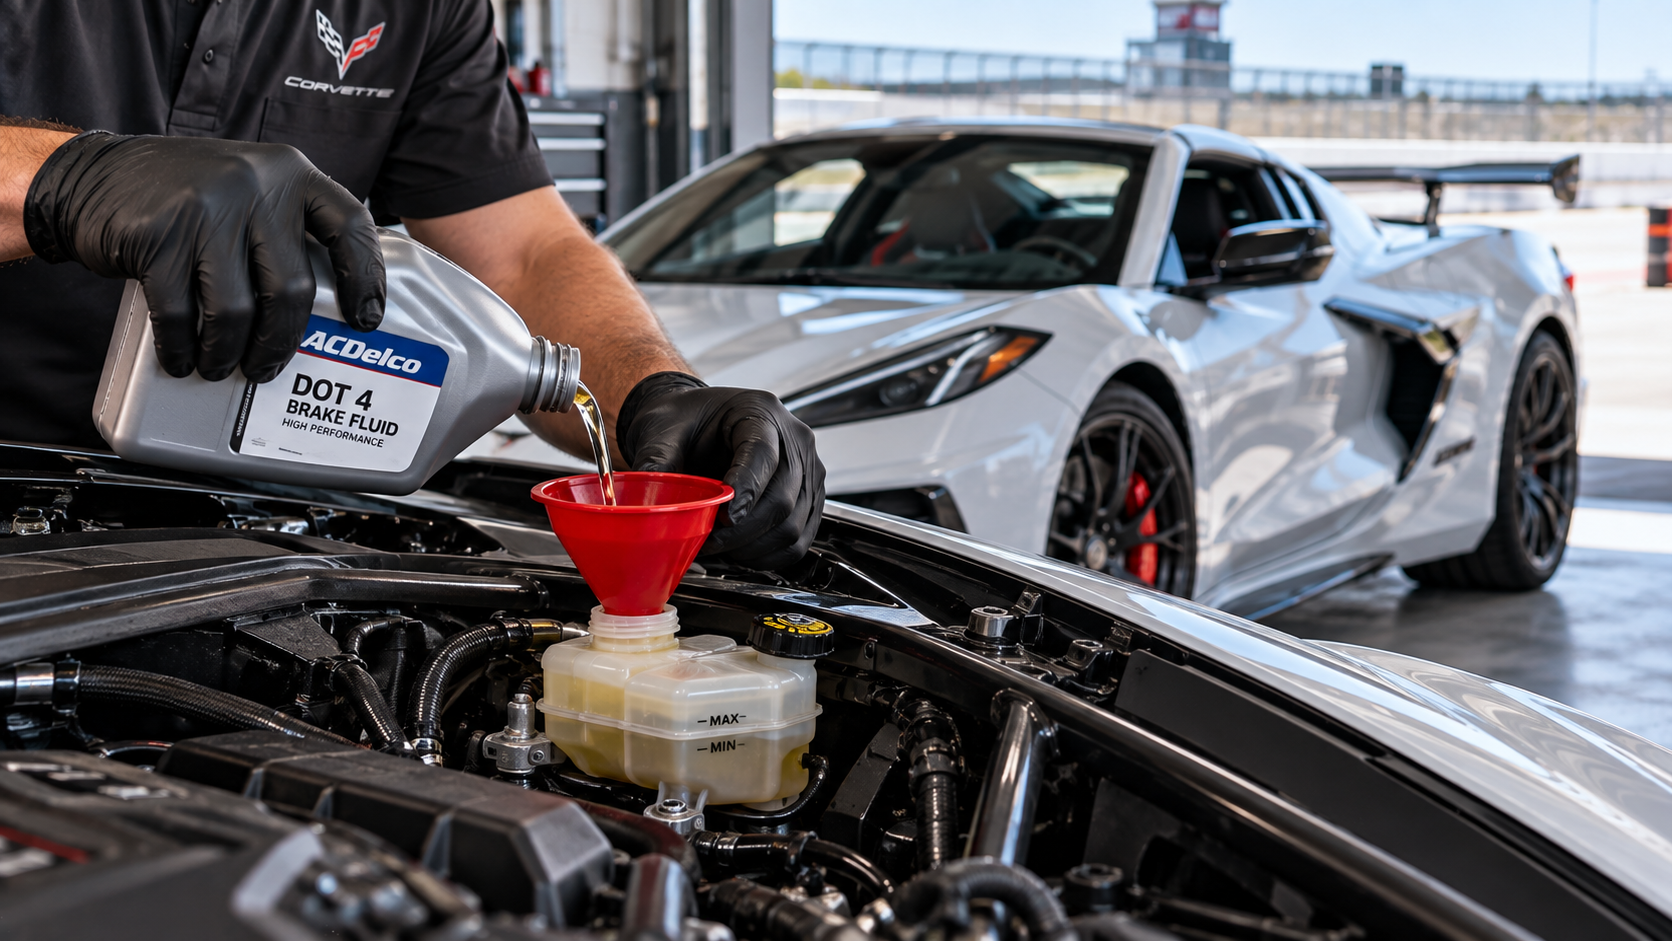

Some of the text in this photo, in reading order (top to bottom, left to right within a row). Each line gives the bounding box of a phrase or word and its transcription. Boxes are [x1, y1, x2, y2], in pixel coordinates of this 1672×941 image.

[284, 76, 395, 98] CORVETTE
[301, 330, 422, 374] ACDelco
[291, 373, 373, 411] DOT 4
[286, 398, 399, 437] BRAKE FLUID
[281, 418, 384, 448] HIGH PERFORMANCE
[709, 713, 739, 727] MAX
[710, 739, 736, 753] MIN
